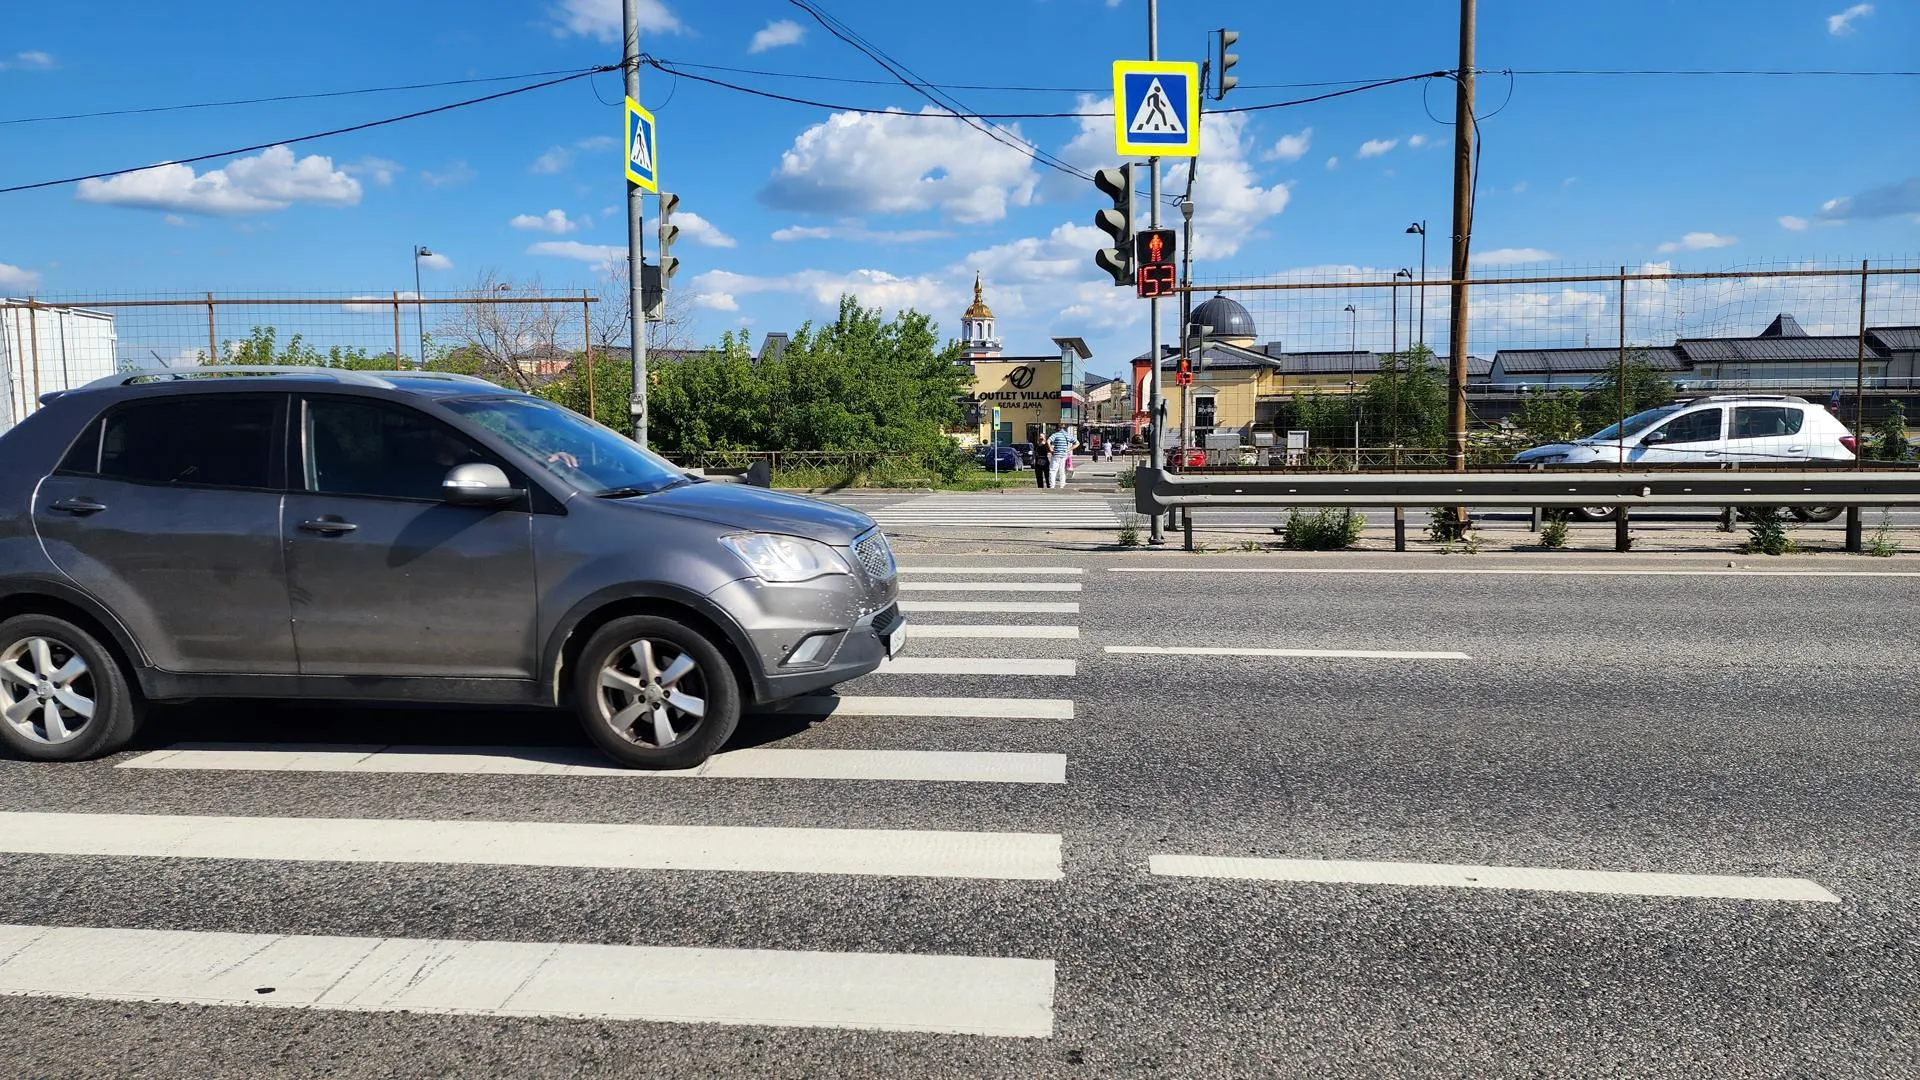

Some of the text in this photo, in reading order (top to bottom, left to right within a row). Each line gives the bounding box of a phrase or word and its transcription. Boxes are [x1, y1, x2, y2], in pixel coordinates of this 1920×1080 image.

[980, 391, 1017, 400] OUTLET
[998, 401, 1042, 409] БЕЛАЯ ДАЧА
